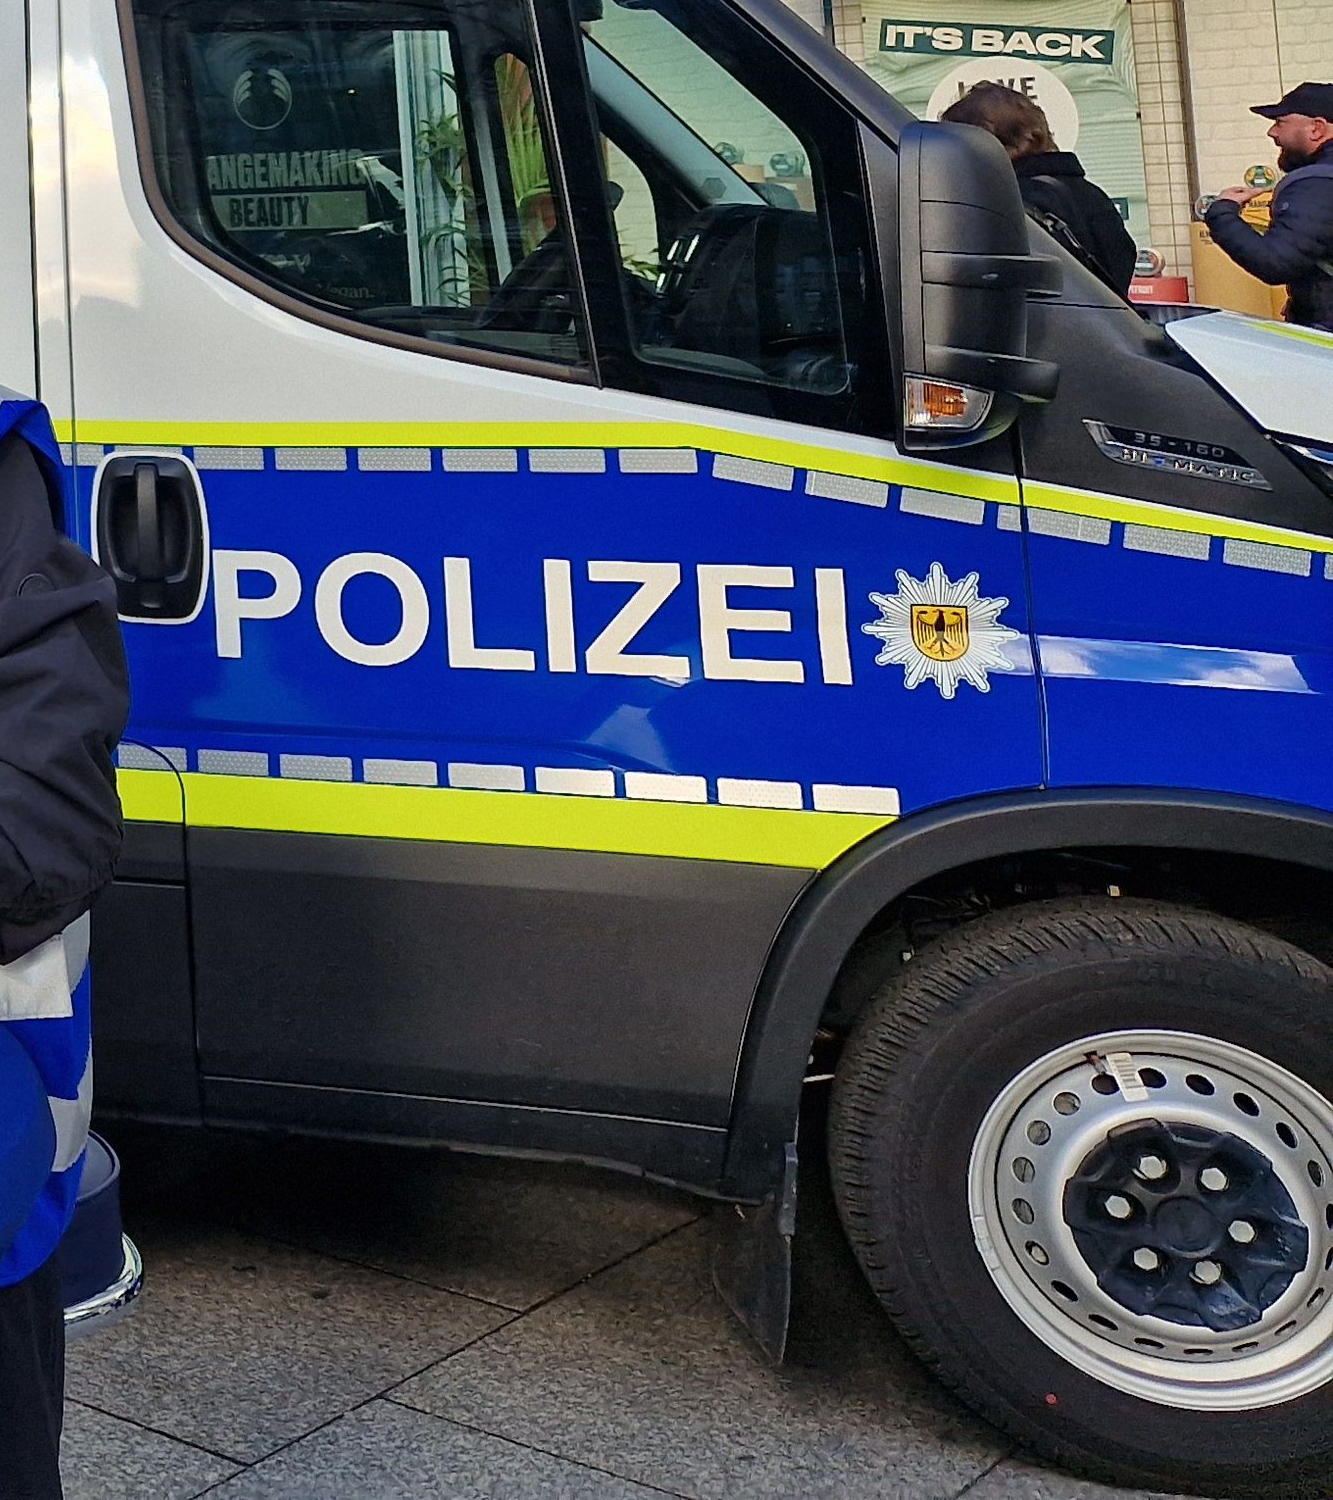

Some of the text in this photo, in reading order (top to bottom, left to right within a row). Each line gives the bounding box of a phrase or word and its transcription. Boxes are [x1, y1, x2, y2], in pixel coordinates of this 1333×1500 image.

[884, 23, 1107, 60] IT'S BACK
[208, 150, 366, 190] ANGEMAKING
[211, 548, 854, 687] POLIZEI
